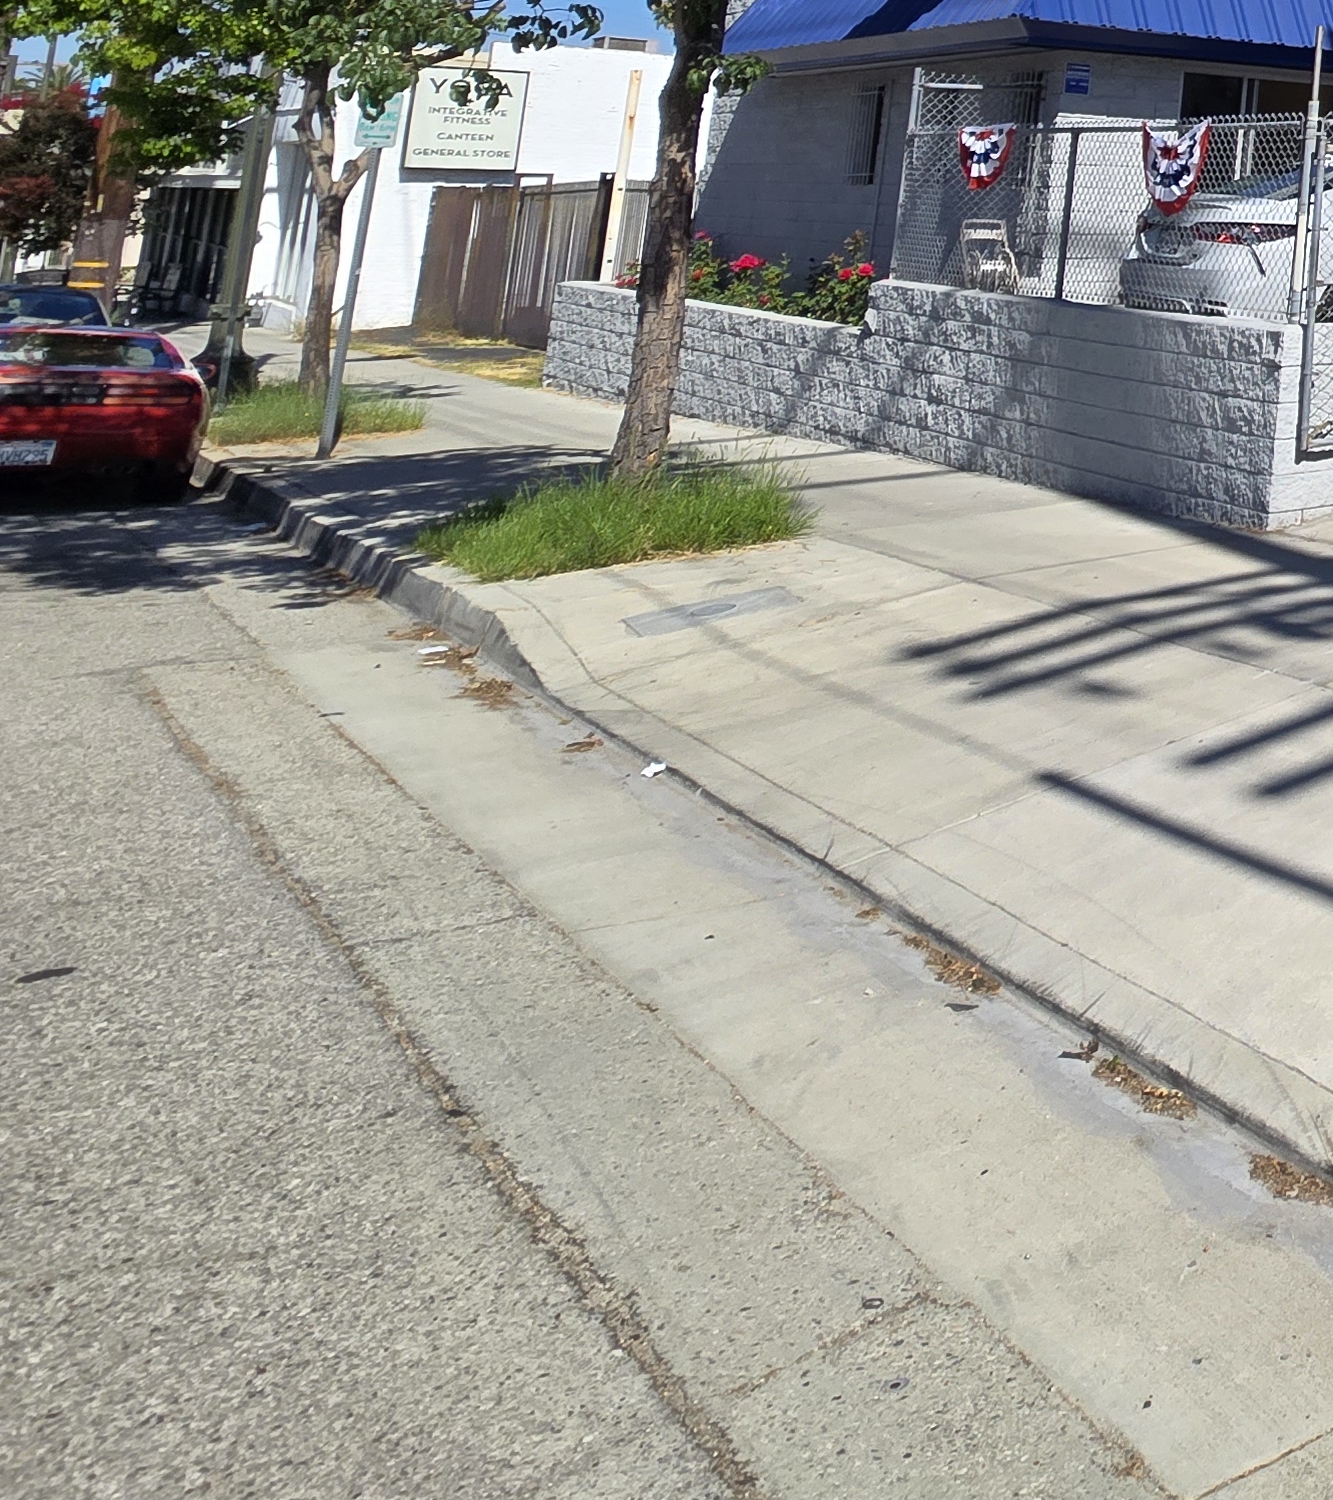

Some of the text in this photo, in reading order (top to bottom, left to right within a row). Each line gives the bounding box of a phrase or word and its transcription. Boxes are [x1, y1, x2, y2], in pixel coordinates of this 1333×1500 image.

[429, 77, 513, 98] YA
[443, 115, 491, 125] FITNESS
[436, 132, 494, 141] CANTEEN
[412, 147, 510, 159] GENERAL STORE
